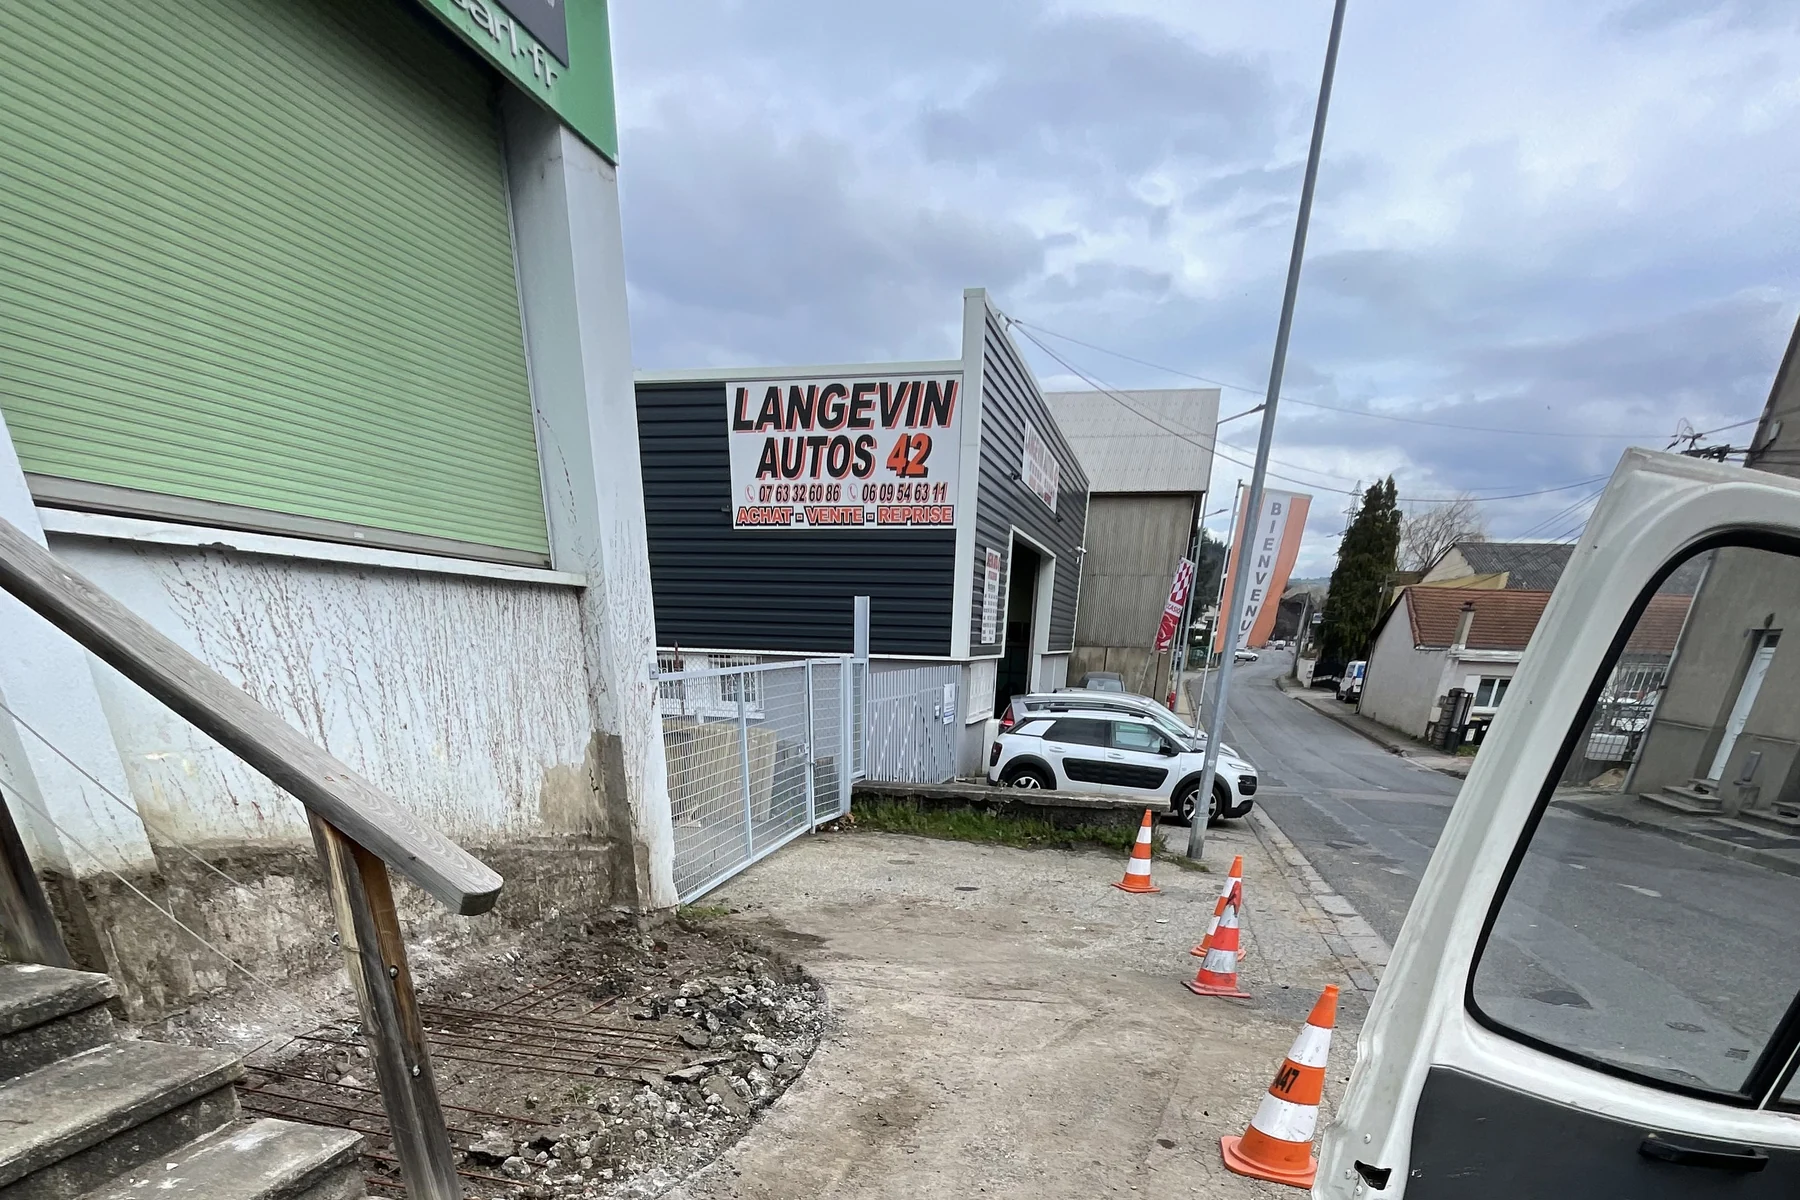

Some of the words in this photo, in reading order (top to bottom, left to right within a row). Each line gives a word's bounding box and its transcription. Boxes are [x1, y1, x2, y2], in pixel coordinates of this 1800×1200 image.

[453, 0, 558, 88] arl.fr
[733, 380, 958, 433] LANGEVIN
[756, 434, 877, 480] AUTOS
[886, 433, 932, 478] 42
[735, 506, 794, 526] ACHAT
[804, 505, 863, 525] VENTE
[877, 505, 954, 526] REPRISE
[759, 484, 774, 502] 07
[775, 484, 789, 502] 63
[791, 484, 807, 502] 32
[808, 484, 824, 502] 60
[825, 484, 841, 502] 86
[862, 484, 877, 503] 06
[879, 483, 895, 503] 09
[896, 483, 912, 502] 54
[914, 483, 930, 502] 63
[932, 482, 948, 502] 11
